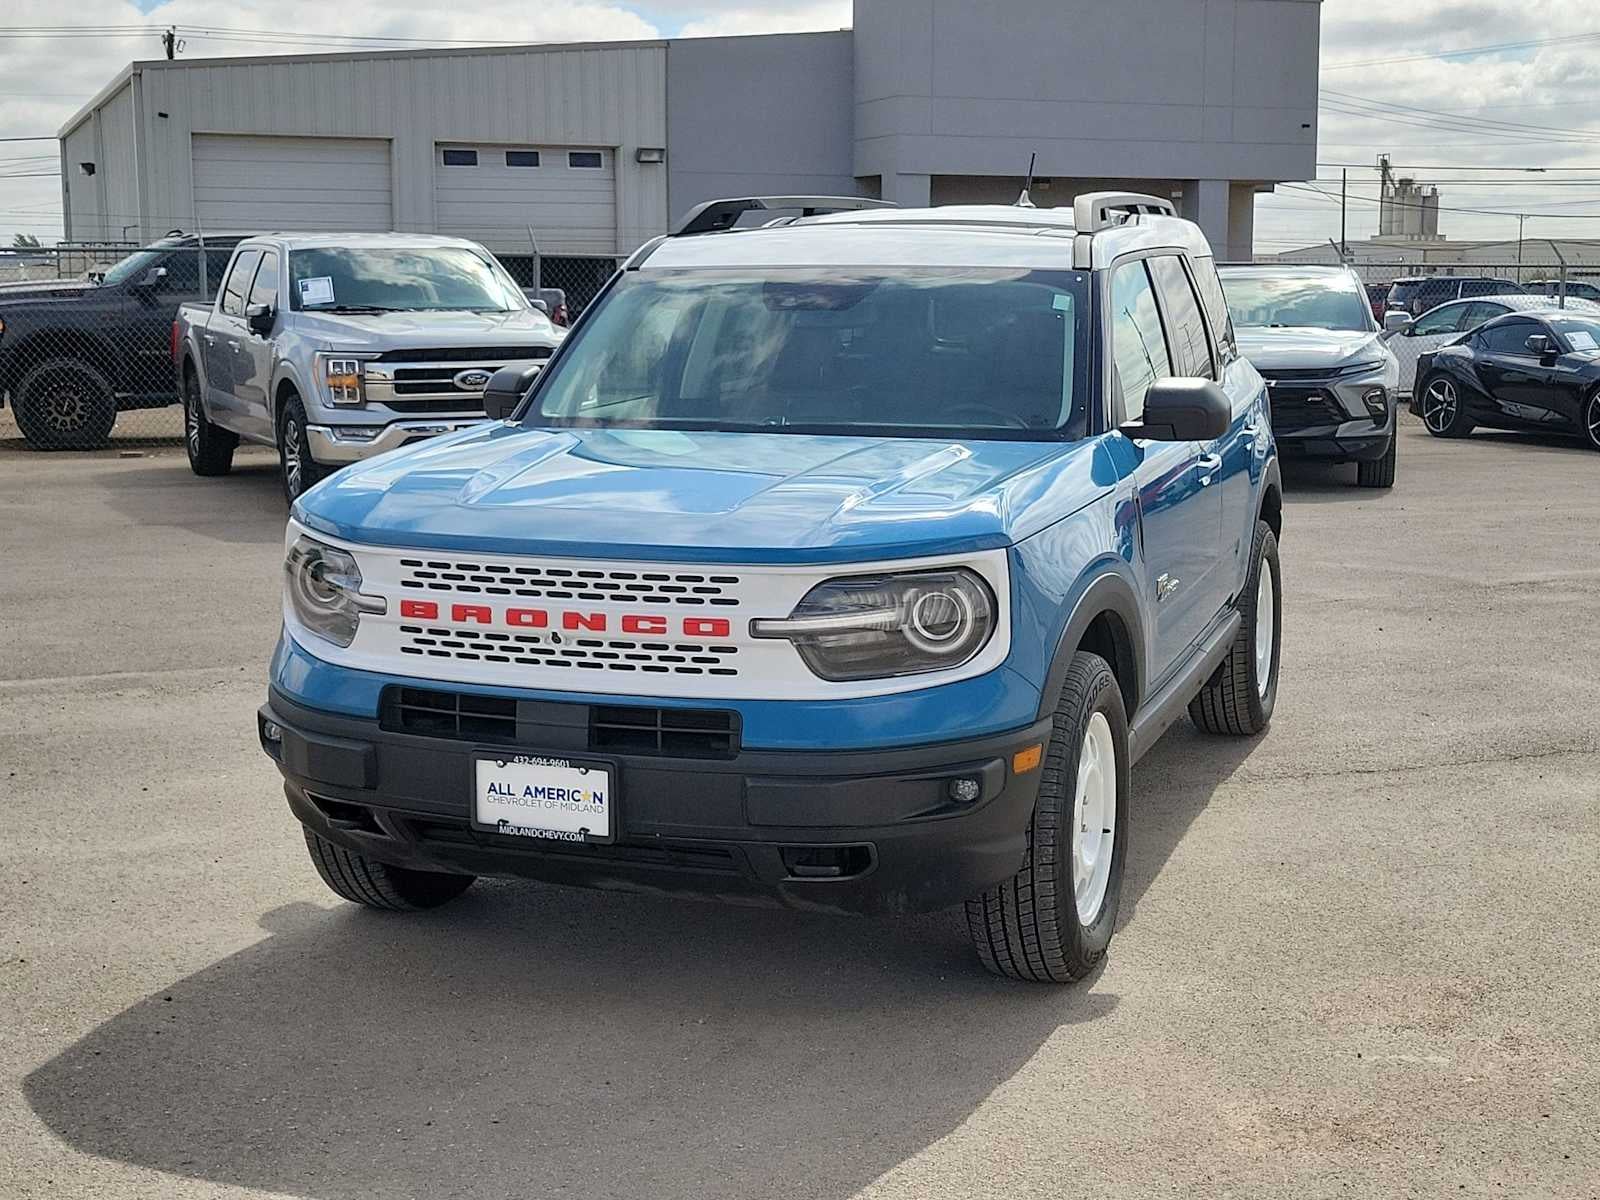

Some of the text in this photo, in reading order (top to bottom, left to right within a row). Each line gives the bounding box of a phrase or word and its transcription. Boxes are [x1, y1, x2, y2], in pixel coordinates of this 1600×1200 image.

[400, 600, 730, 637] BRONCO
[513, 756, 570, 767] 432-694-9601
[488, 783, 515, 796] ALL
[487, 795, 604, 814] CHEVROLET OF MIDLAND
[499, 826, 585, 842] MIDLANDCHEVY.COM
